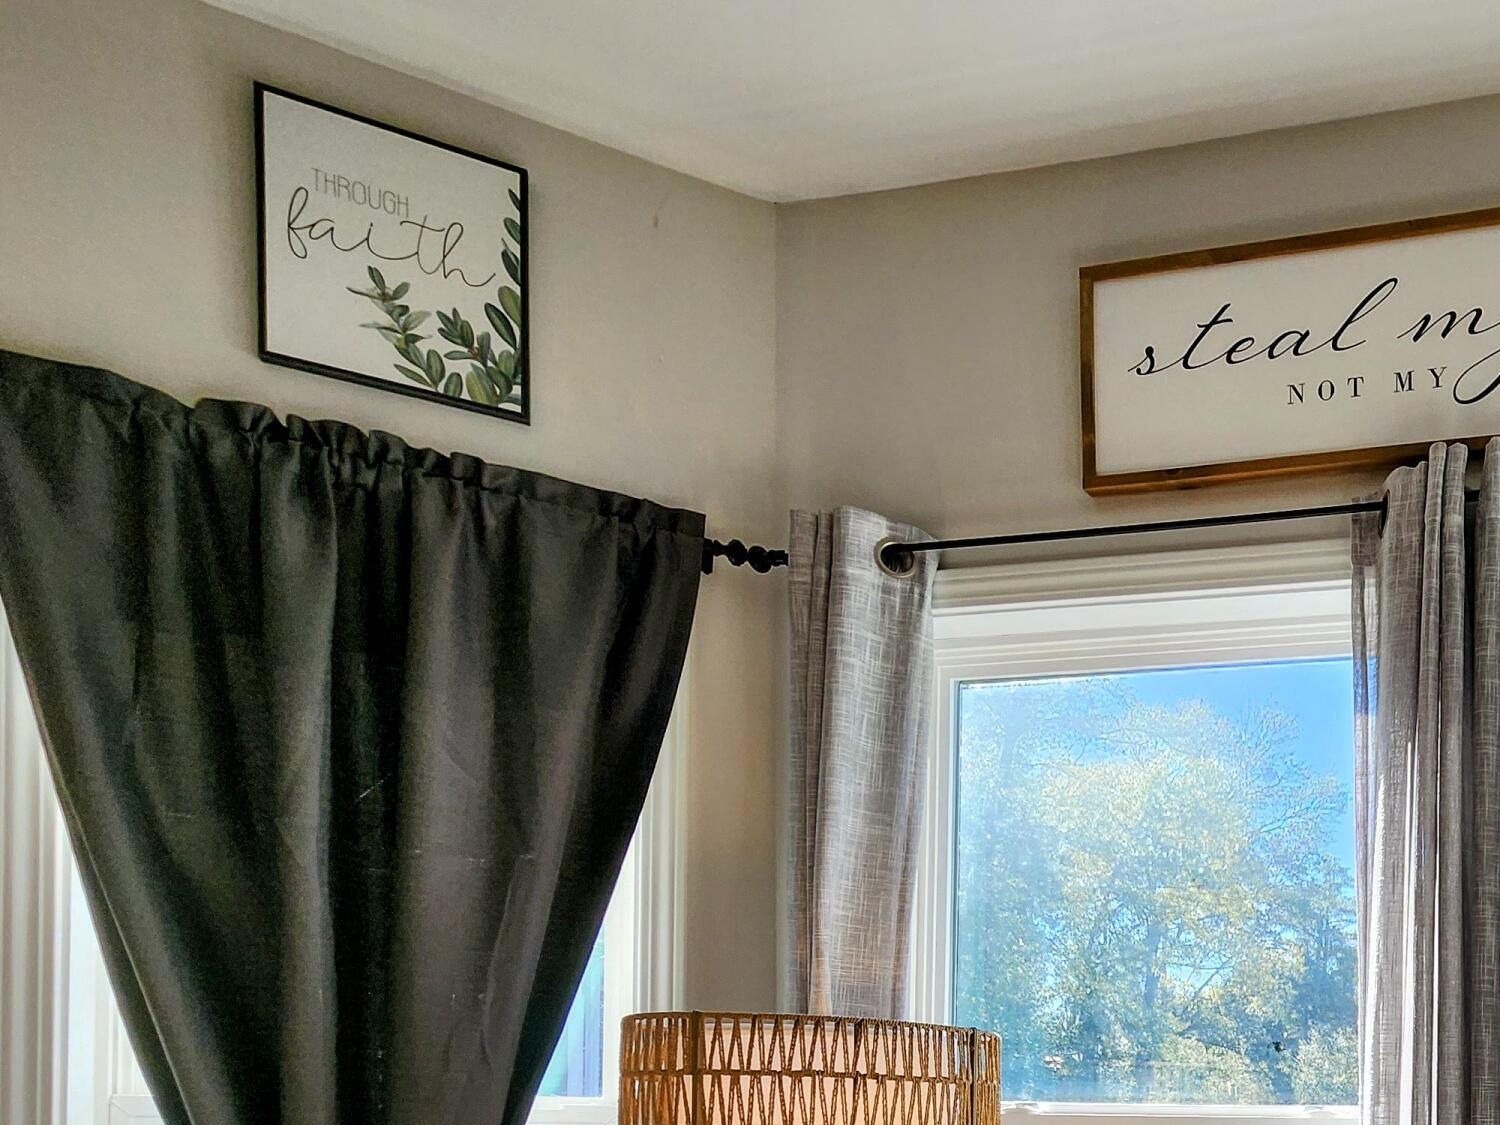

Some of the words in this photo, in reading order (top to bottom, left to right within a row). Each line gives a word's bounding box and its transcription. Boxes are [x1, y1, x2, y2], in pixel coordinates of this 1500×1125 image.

[311, 167, 410, 219] THROUGH
[286, 186, 497, 288] faith
[1127, 277, 1399, 376] steal
[1286, 377, 1365, 405] NOT
[1393, 365, 1448, 393] MY
